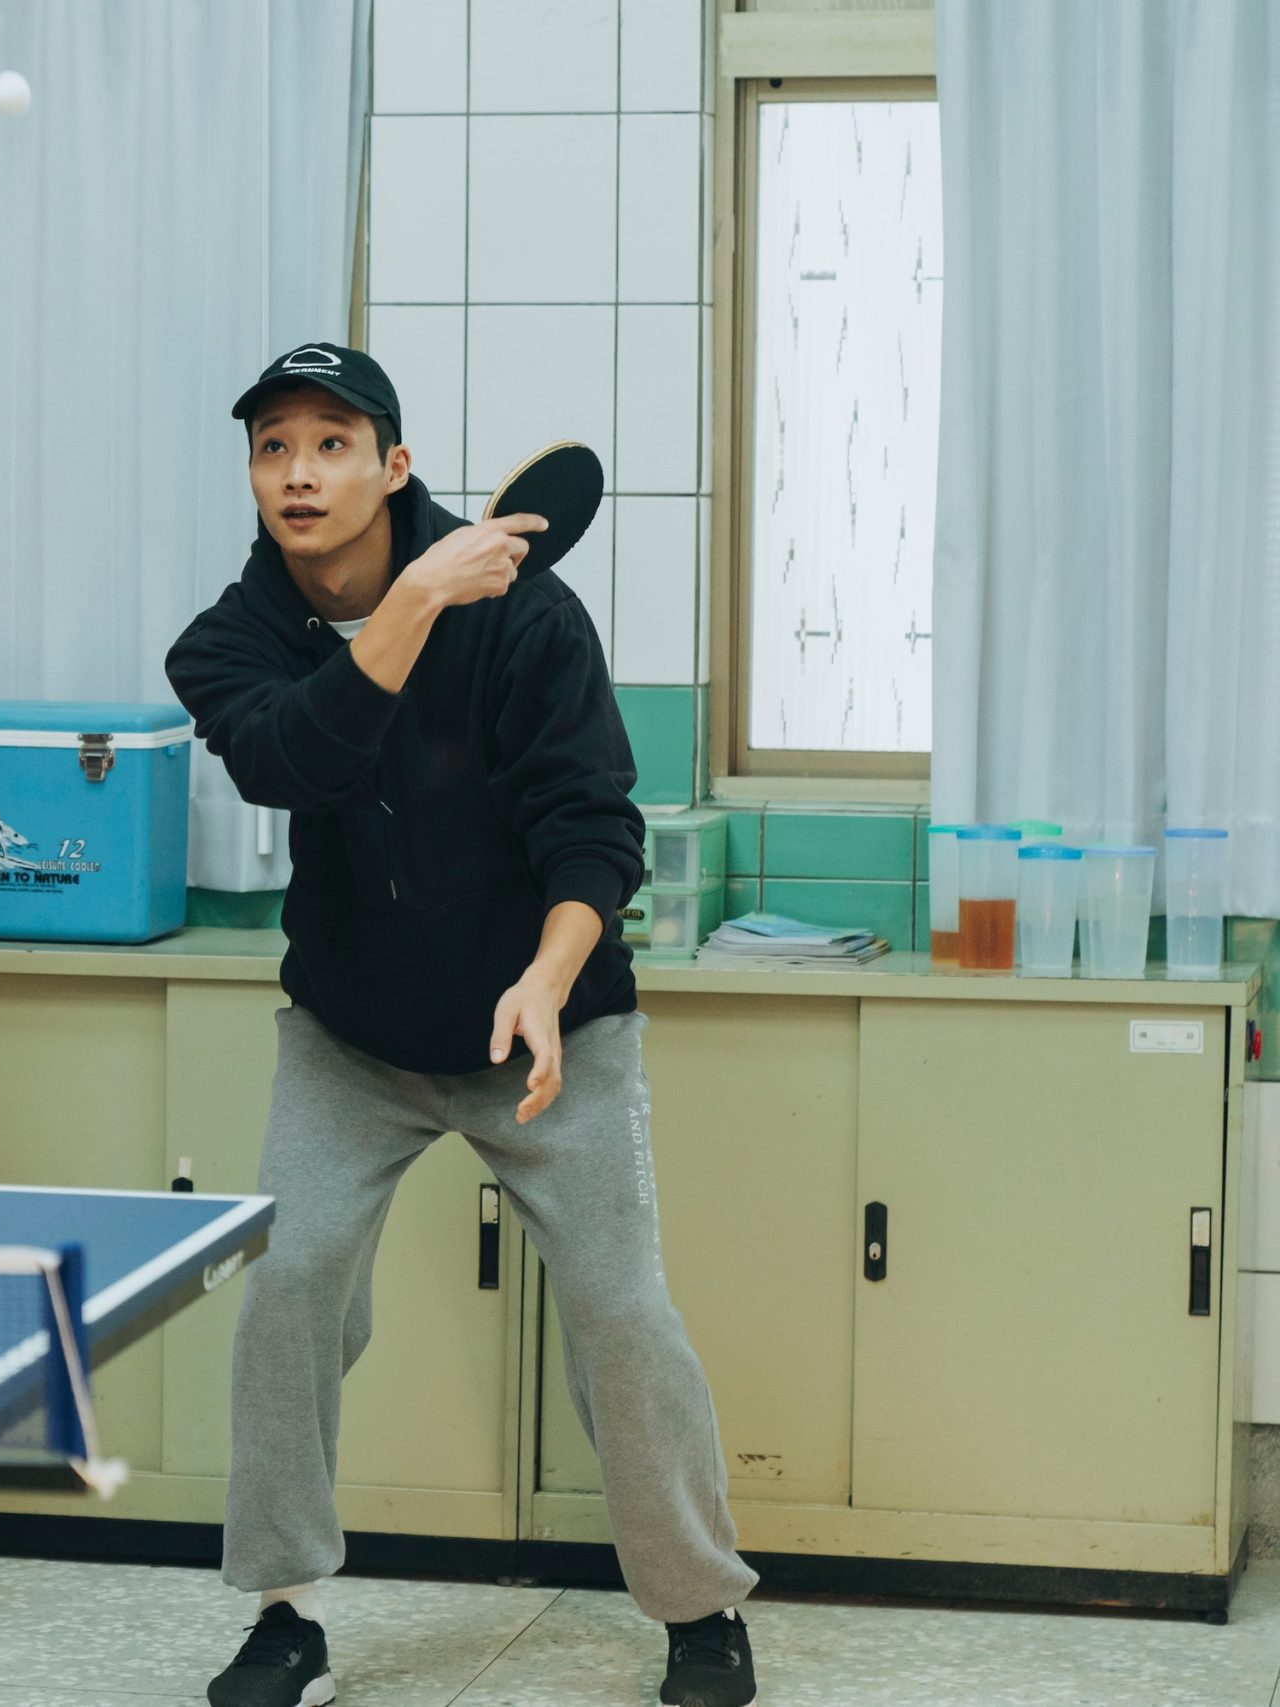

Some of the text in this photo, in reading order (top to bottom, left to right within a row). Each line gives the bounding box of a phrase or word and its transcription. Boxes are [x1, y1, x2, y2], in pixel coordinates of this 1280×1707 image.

[57, 839, 86, 859] 12
[14, 871, 30, 883] TO
[35, 871, 80, 885] NATURE
[628, 1106, 650, 1205] AND FITCH
